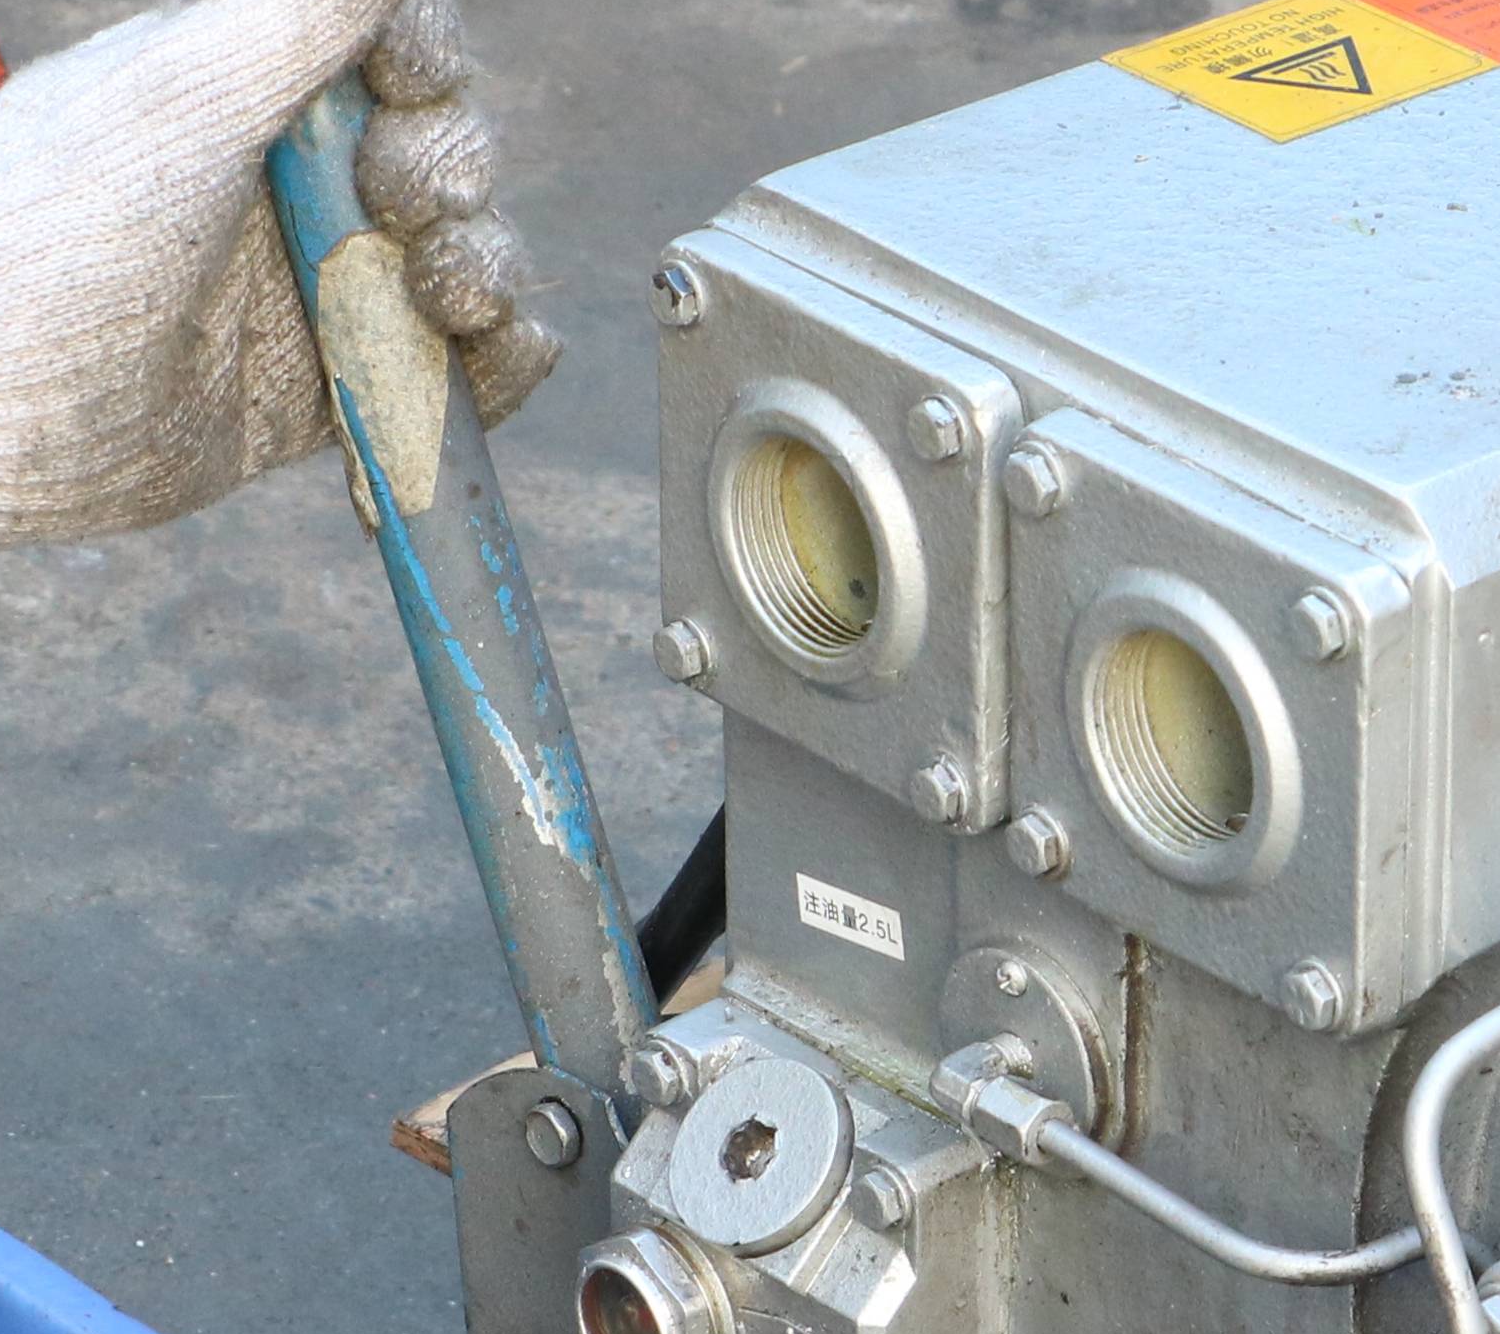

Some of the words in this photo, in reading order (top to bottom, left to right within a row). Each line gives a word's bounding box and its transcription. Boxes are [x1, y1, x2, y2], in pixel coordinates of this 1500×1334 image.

[1266, 8, 1300, 22] NO
[1294, 7, 1344, 26] HIGH
[1156, 22, 1298, 73] TEMPERATURE
[1168, 18, 1272, 56] TOUCHING
[804, 890, 898, 945] 注油量2.5L
